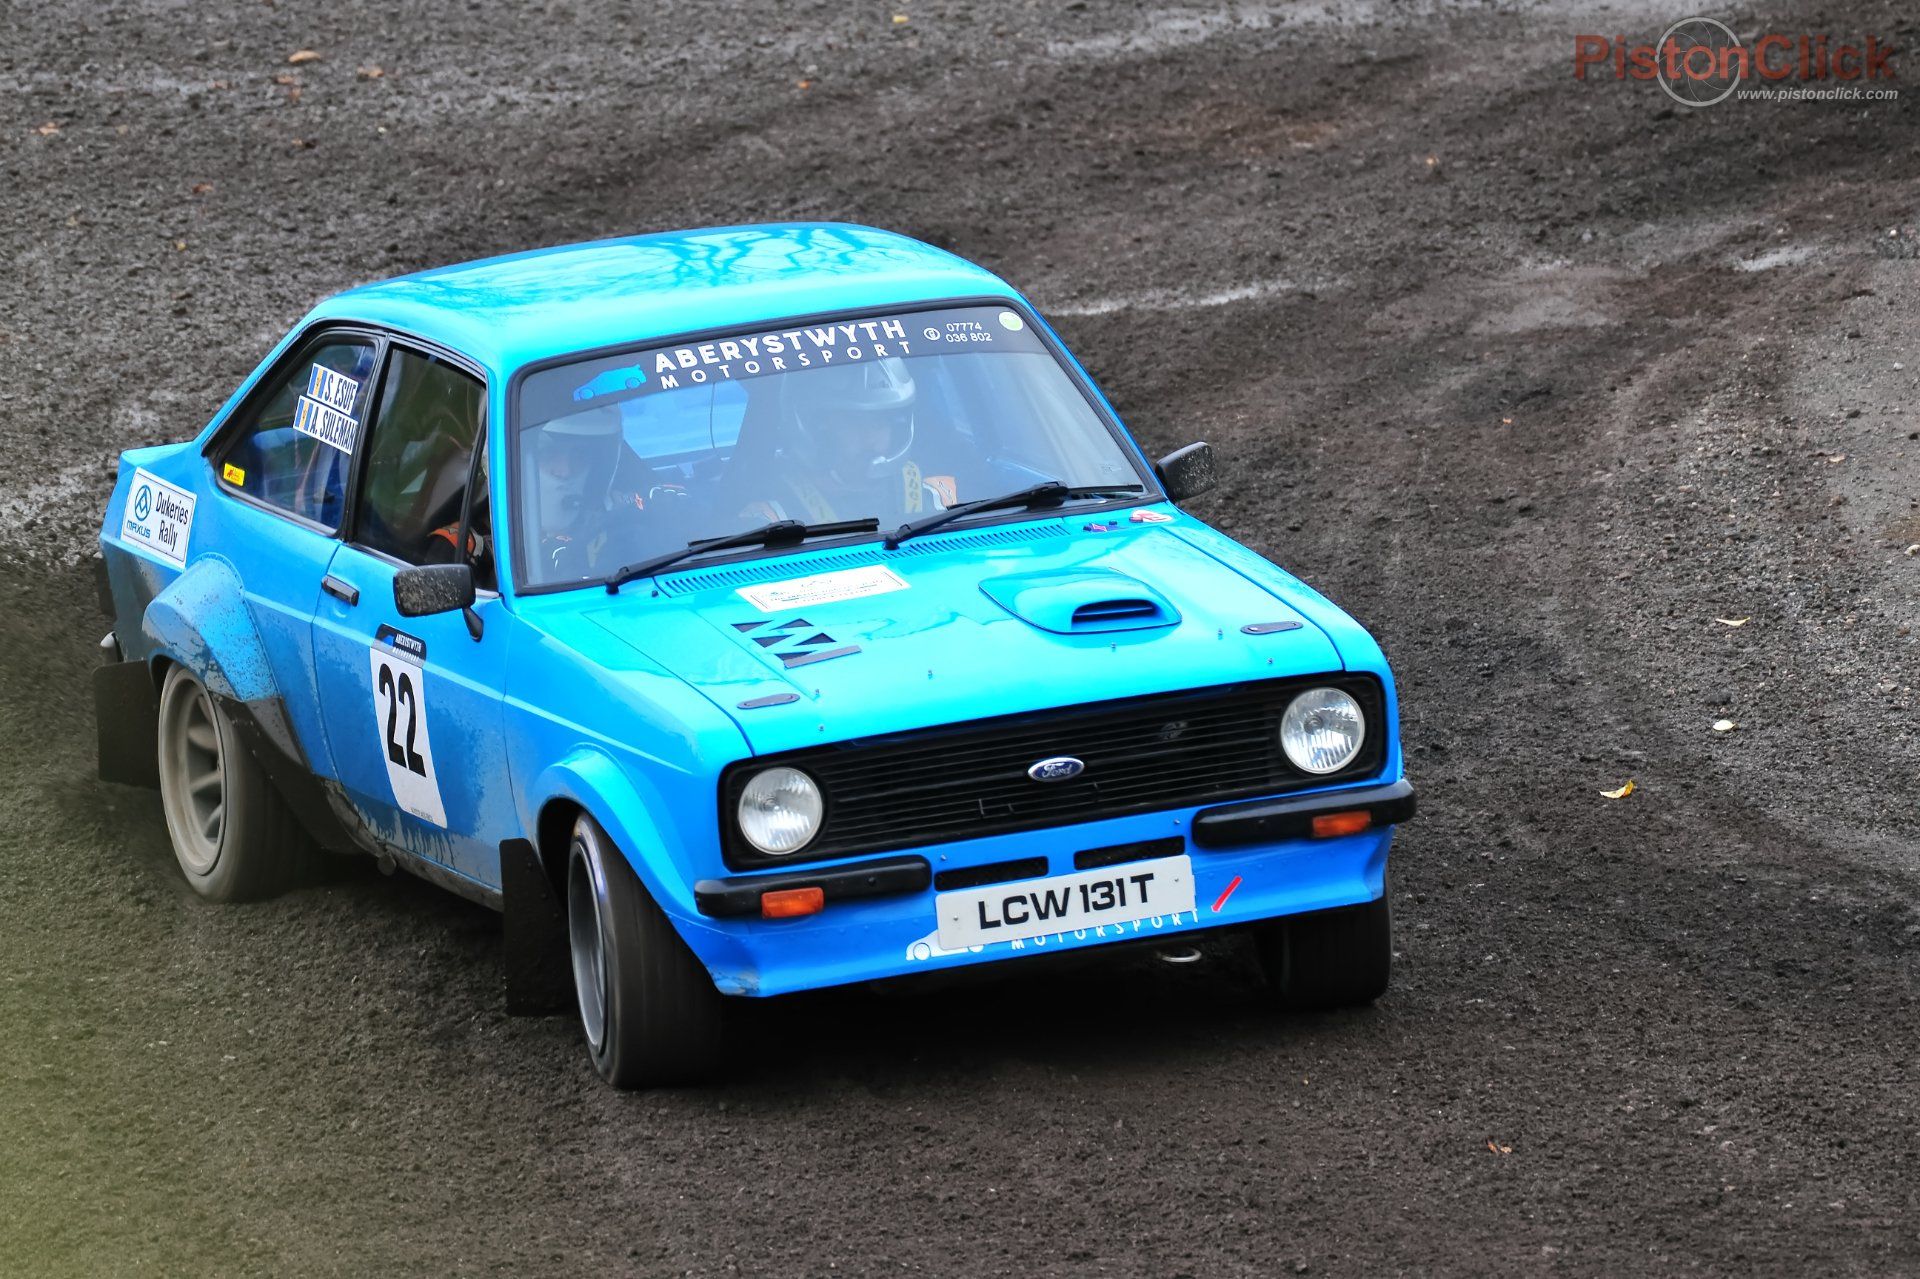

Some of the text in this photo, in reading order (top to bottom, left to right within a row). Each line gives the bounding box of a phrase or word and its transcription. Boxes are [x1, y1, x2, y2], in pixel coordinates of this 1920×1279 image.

[946, 321, 982, 332] 07774
[970, 332, 993, 342] 802
[655, 319, 906, 373] ABERYSTWYTH
[660, 341, 911, 390] MOTORSPORT
[324, 373, 357, 411] S. ESUF
[309, 406, 356, 452] A. SULEMAN
[155, 491, 189, 525] Dukeries
[126, 519, 151, 539] MAXUS
[158, 519, 178, 552] Rally
[378, 663, 427, 778] 22
[1041, 761, 1073, 778] Ford
[978, 887, 1070, 930] LCW
